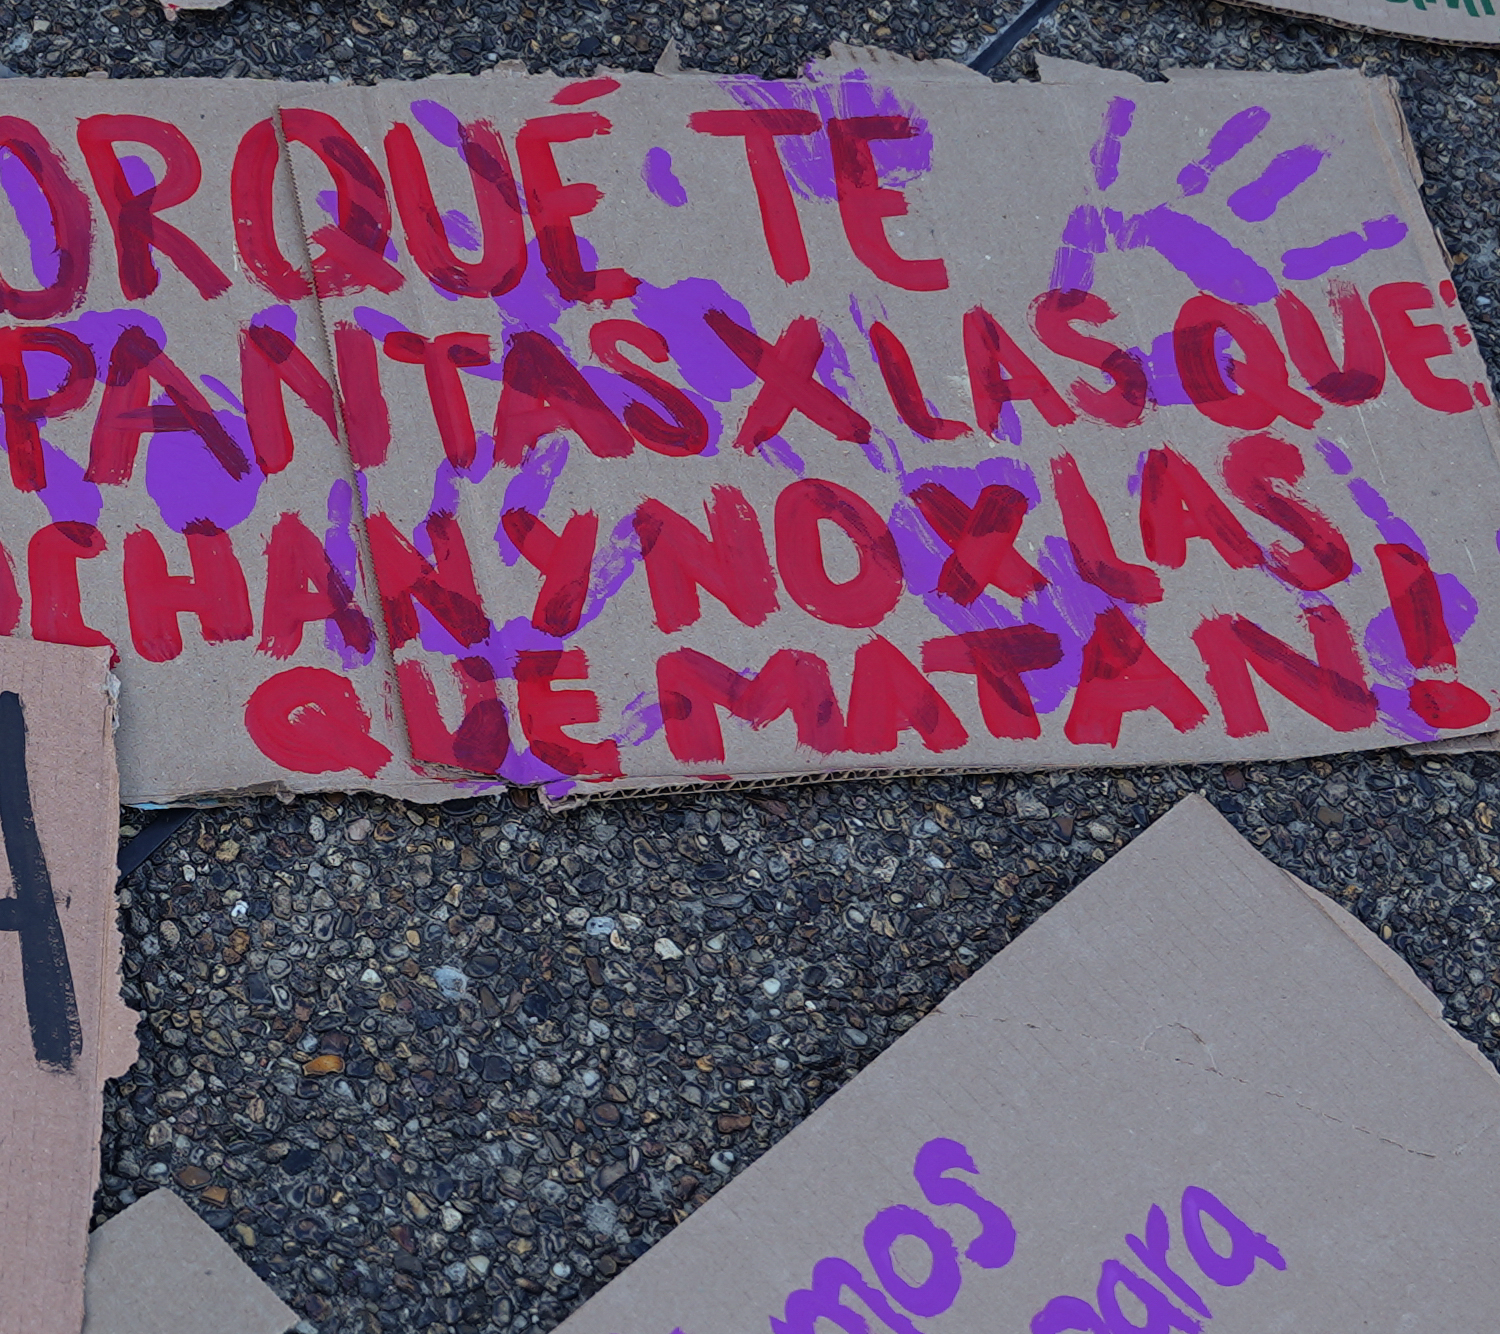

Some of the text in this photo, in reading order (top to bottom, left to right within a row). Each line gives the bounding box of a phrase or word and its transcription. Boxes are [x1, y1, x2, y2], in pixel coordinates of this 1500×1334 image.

[686, 108, 949, 292] TE
[869, 288, 1148, 441] LAS
[500, 507, 598, 638] Y
[632, 477, 905, 635] NO
[1051, 429, 1357, 604] LAS
[243, 543, 1496, 780] QUE MATAN!
